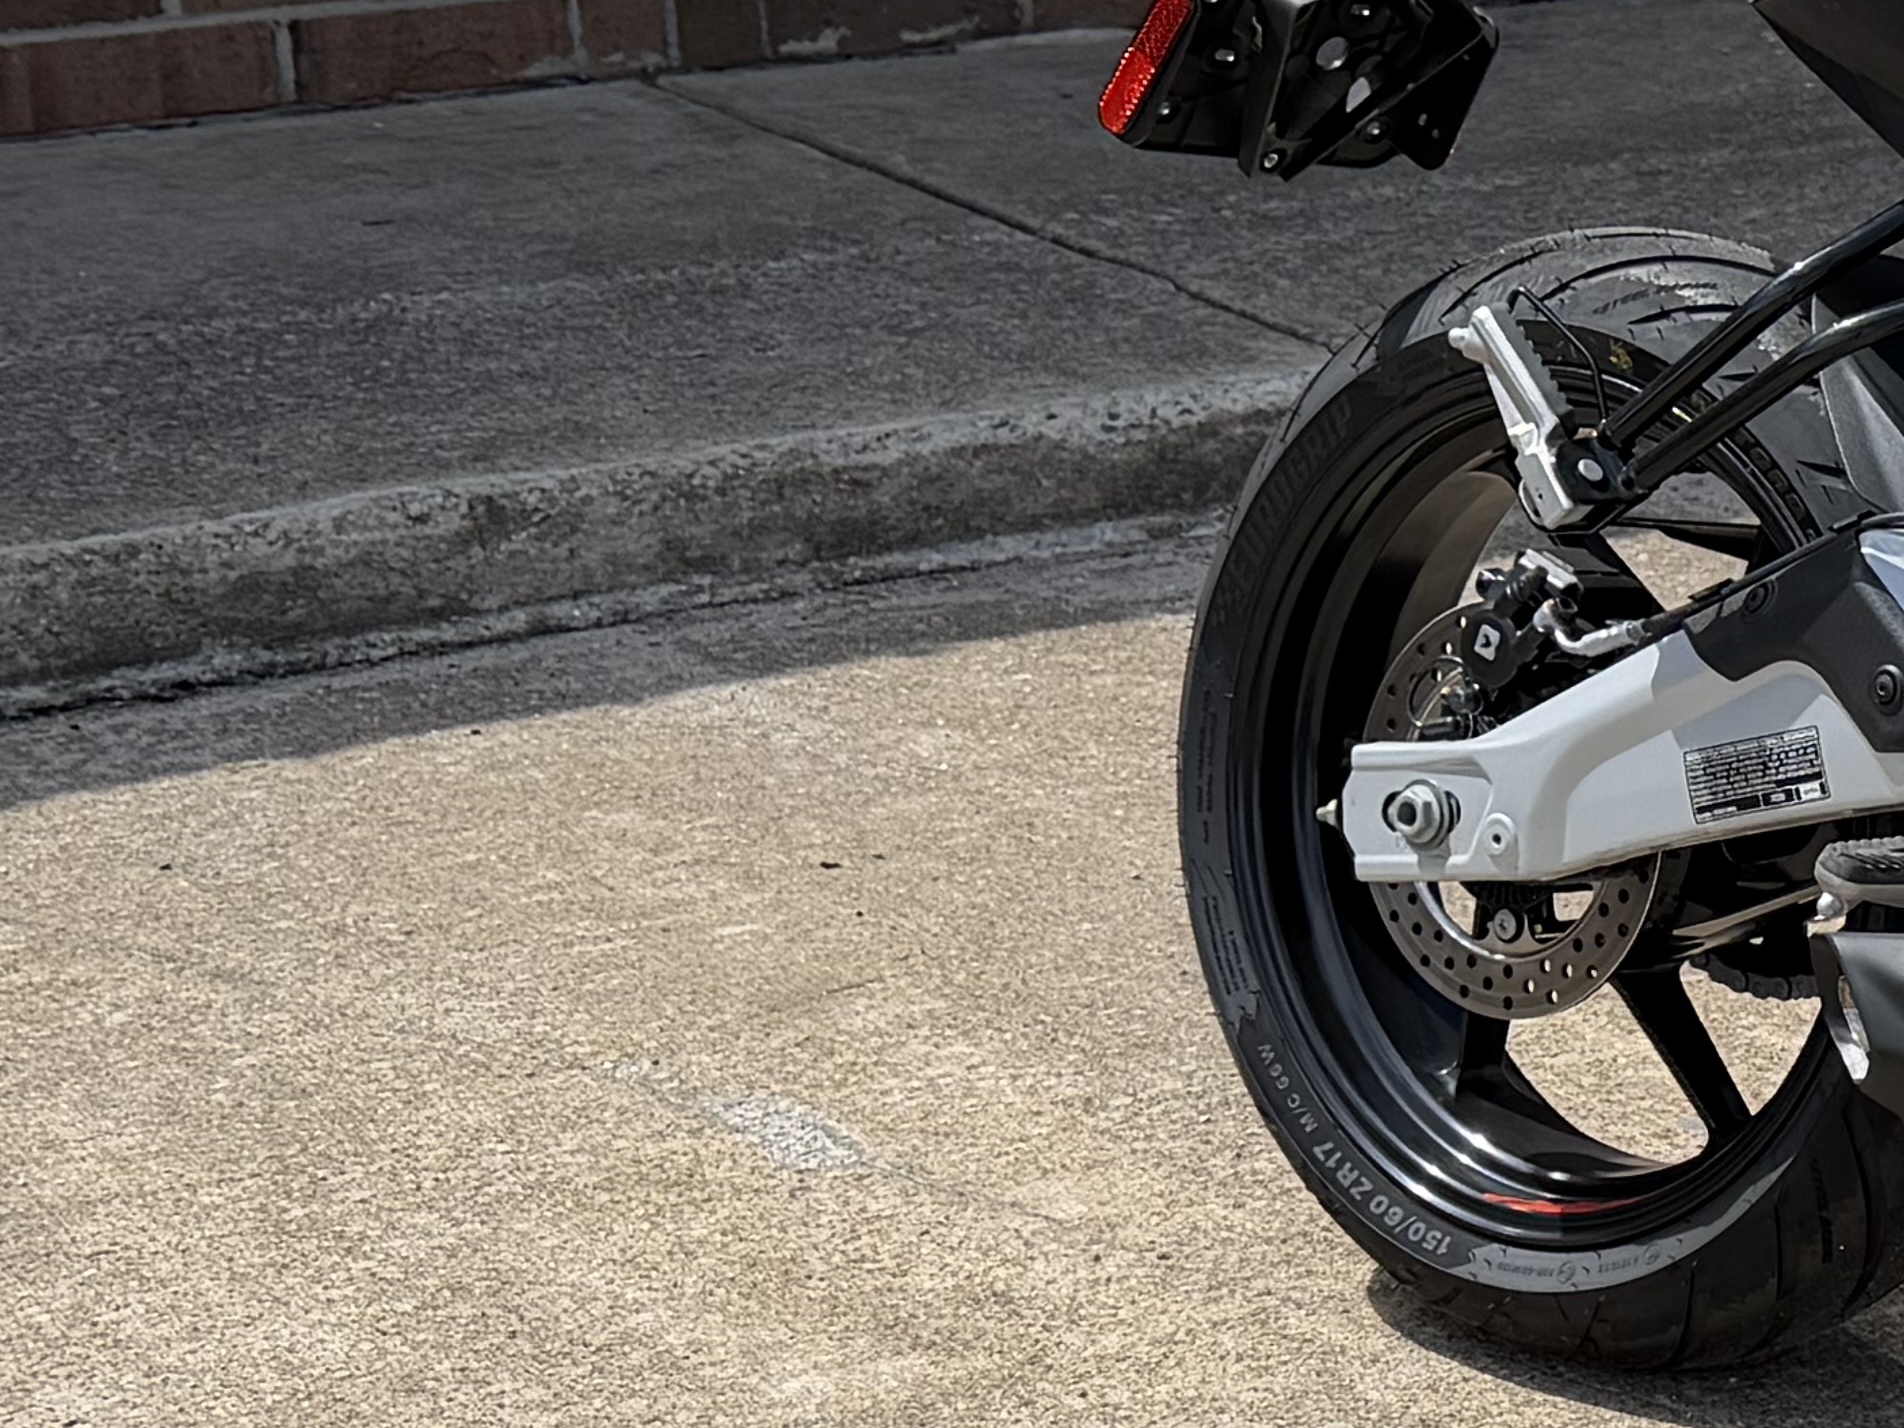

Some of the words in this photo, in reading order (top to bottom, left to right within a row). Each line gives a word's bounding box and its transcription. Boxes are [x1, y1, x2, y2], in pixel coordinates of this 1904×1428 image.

[1257, 1043, 1291, 1090] 66W
[1287, 1093, 1319, 1133] M/C
[1312, 1141, 1375, 1201] ZR17
[1369, 1194, 1452, 1256] 150/60
